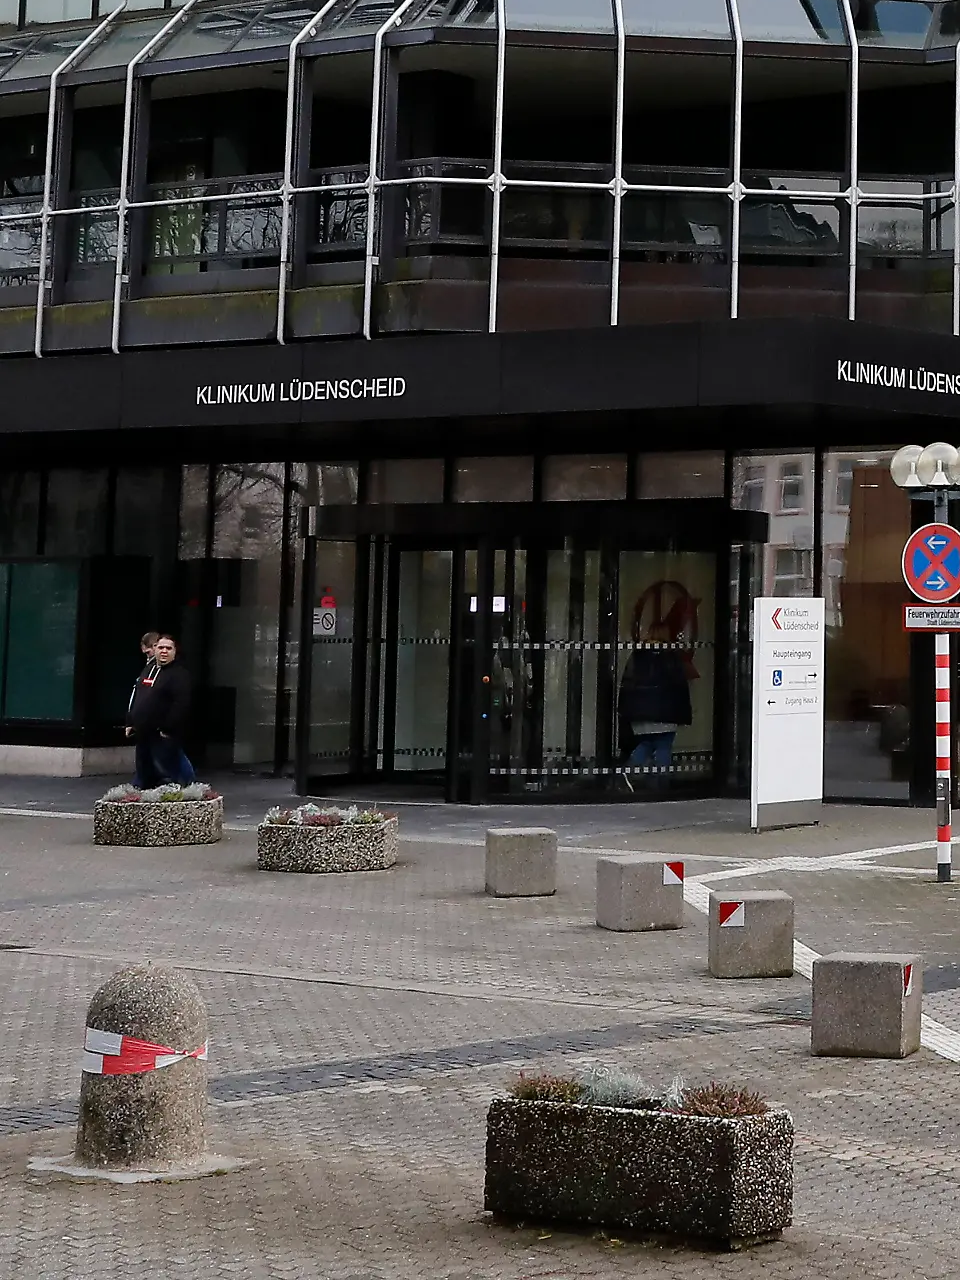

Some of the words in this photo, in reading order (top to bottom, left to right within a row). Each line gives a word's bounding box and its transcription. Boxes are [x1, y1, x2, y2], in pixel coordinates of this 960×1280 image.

[838, 360, 906, 388] KLINIKUM
[197, 383, 275, 404] KLINIKUM
[280, 378, 406, 401] LÜDENSCHEID
[783, 608, 809, 617] Klinikum
[783, 621, 819, 630] Lüdenscheid
[772, 650, 812, 660] Haupteingang
[785, 697, 802, 706] Zugang
